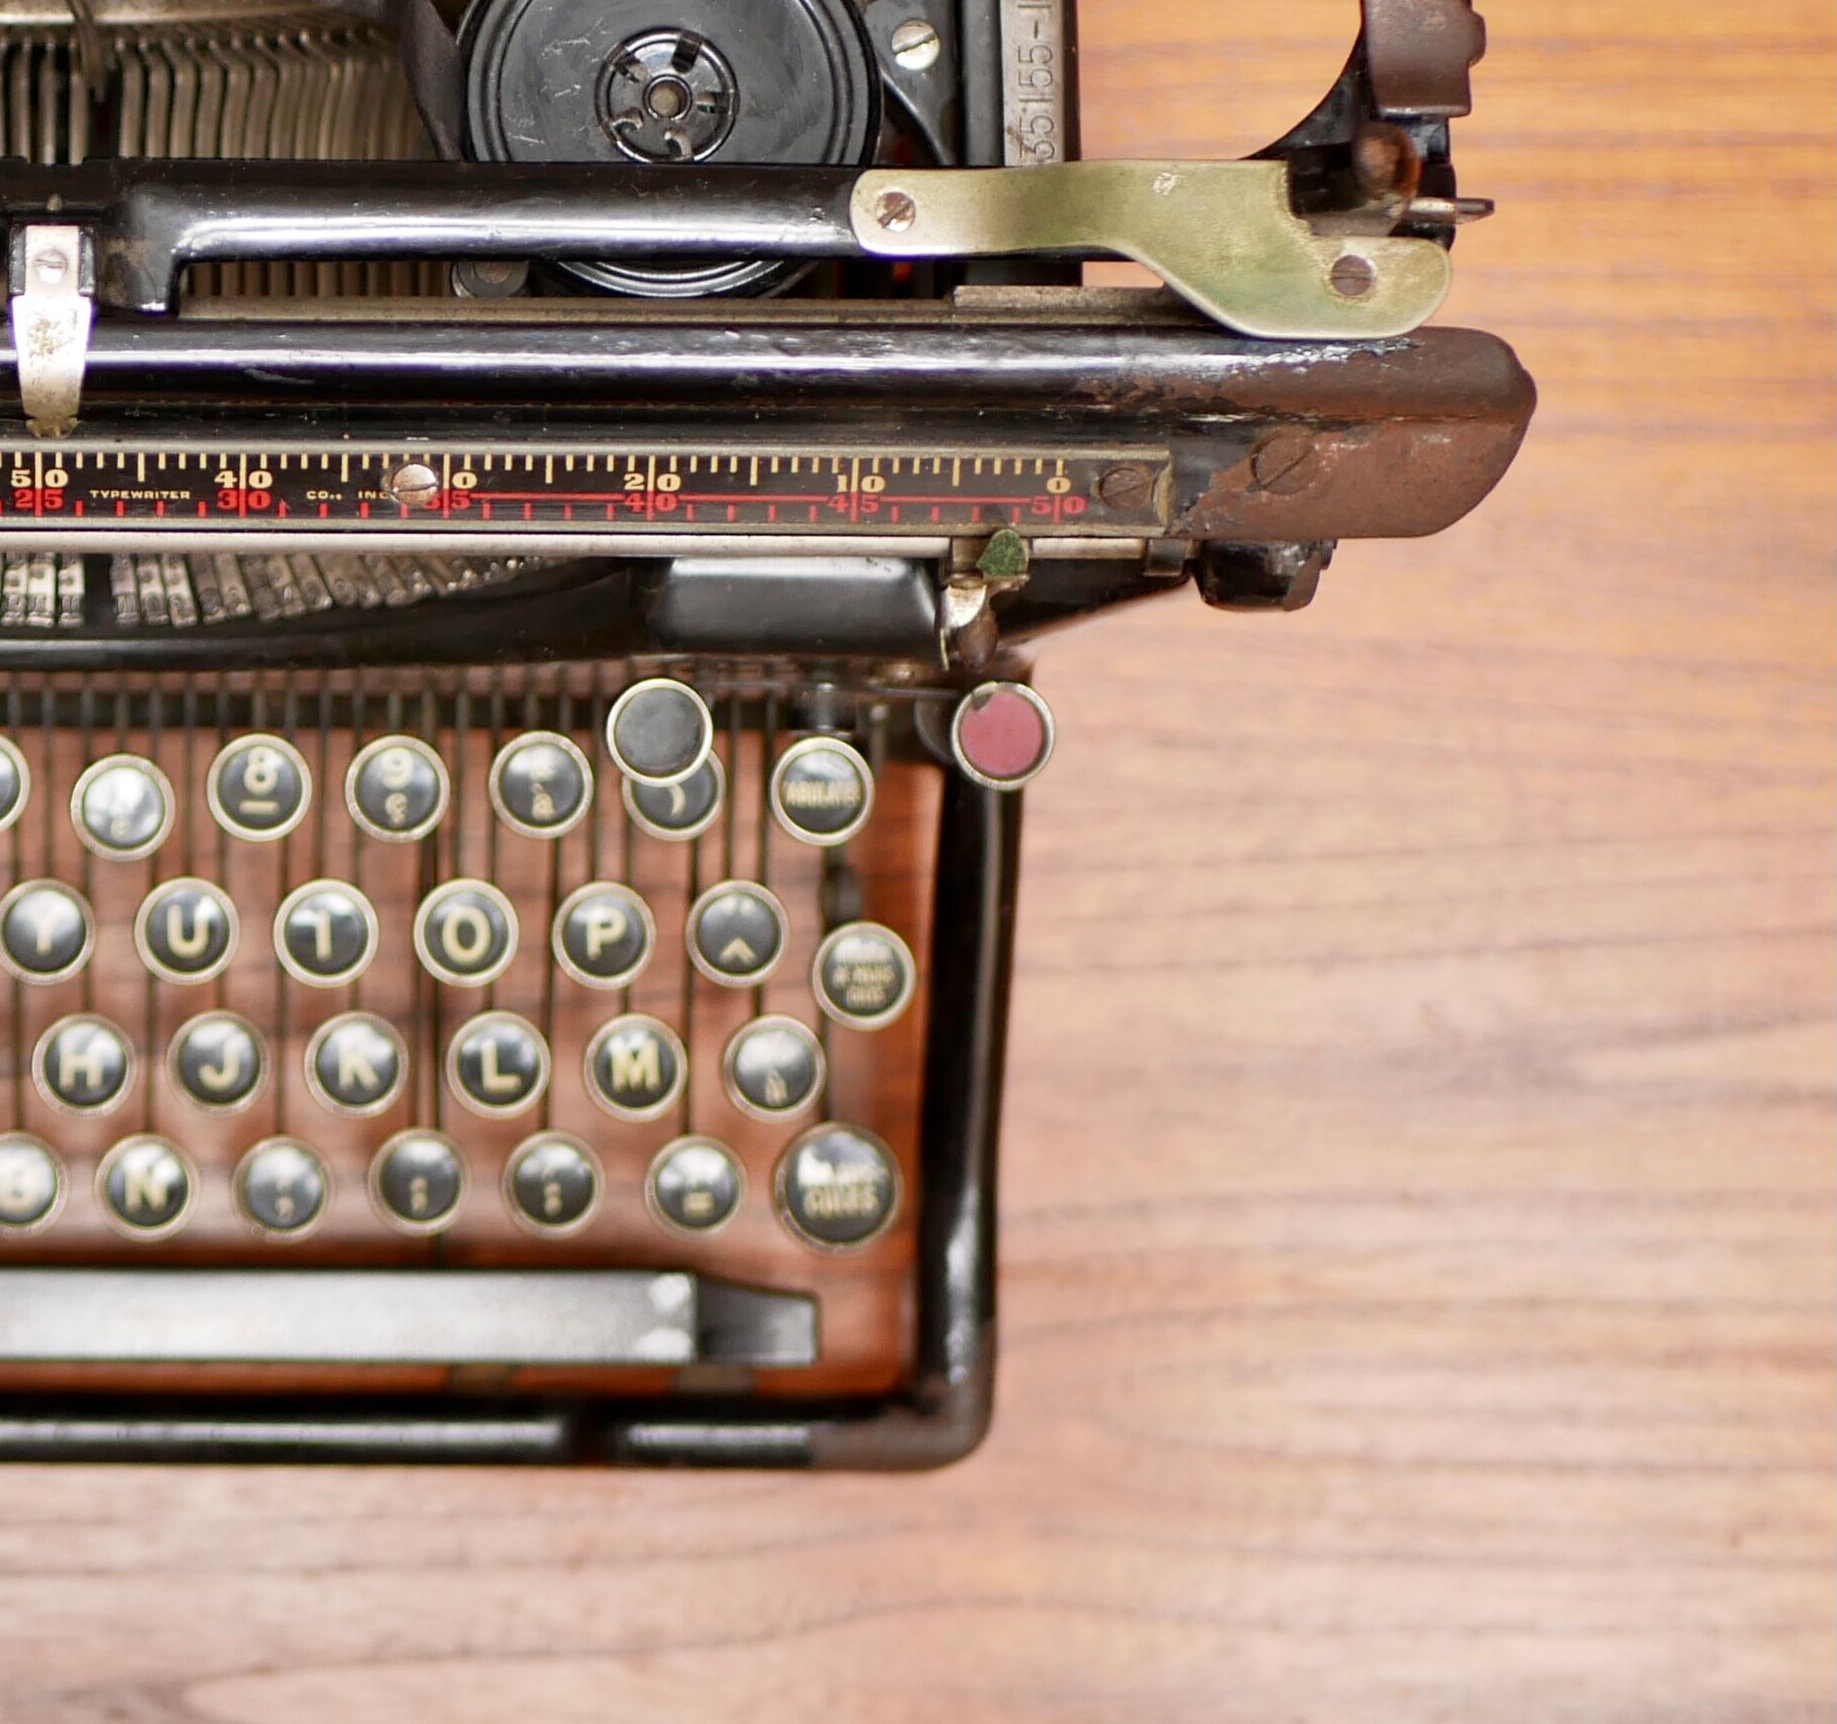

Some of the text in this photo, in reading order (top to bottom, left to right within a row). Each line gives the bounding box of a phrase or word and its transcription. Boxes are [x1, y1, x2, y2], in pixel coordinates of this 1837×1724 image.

[10, 468, 69, 488] 50
[214, 470, 273, 488] 40
[623, 473, 682, 492] 20
[836, 474, 886, 493] 10
[1046, 476, 1072, 494] 0
[14, 488, 64, 509] 25
[217, 489, 271, 510] 30
[624, 492, 678, 512] 40
[827, 494, 880, 514] 45
[1030, 495, 1087, 515] 50
[89, 489, 191, 500] TYPEWRITER
[245, 747, 277, 795] 8
[382, 749, 412, 789] 9
[166, 904, 209, 957] U
[584, 904, 627, 960] P
[58, 1039, 103, 1090] H
[199, 1038, 241, 1091] J
[338, 1038, 379, 1091] K
[481, 1037, 522, 1093] L
[610, 1037, 662, 1093] M
[124, 1160, 168, 1214] N
